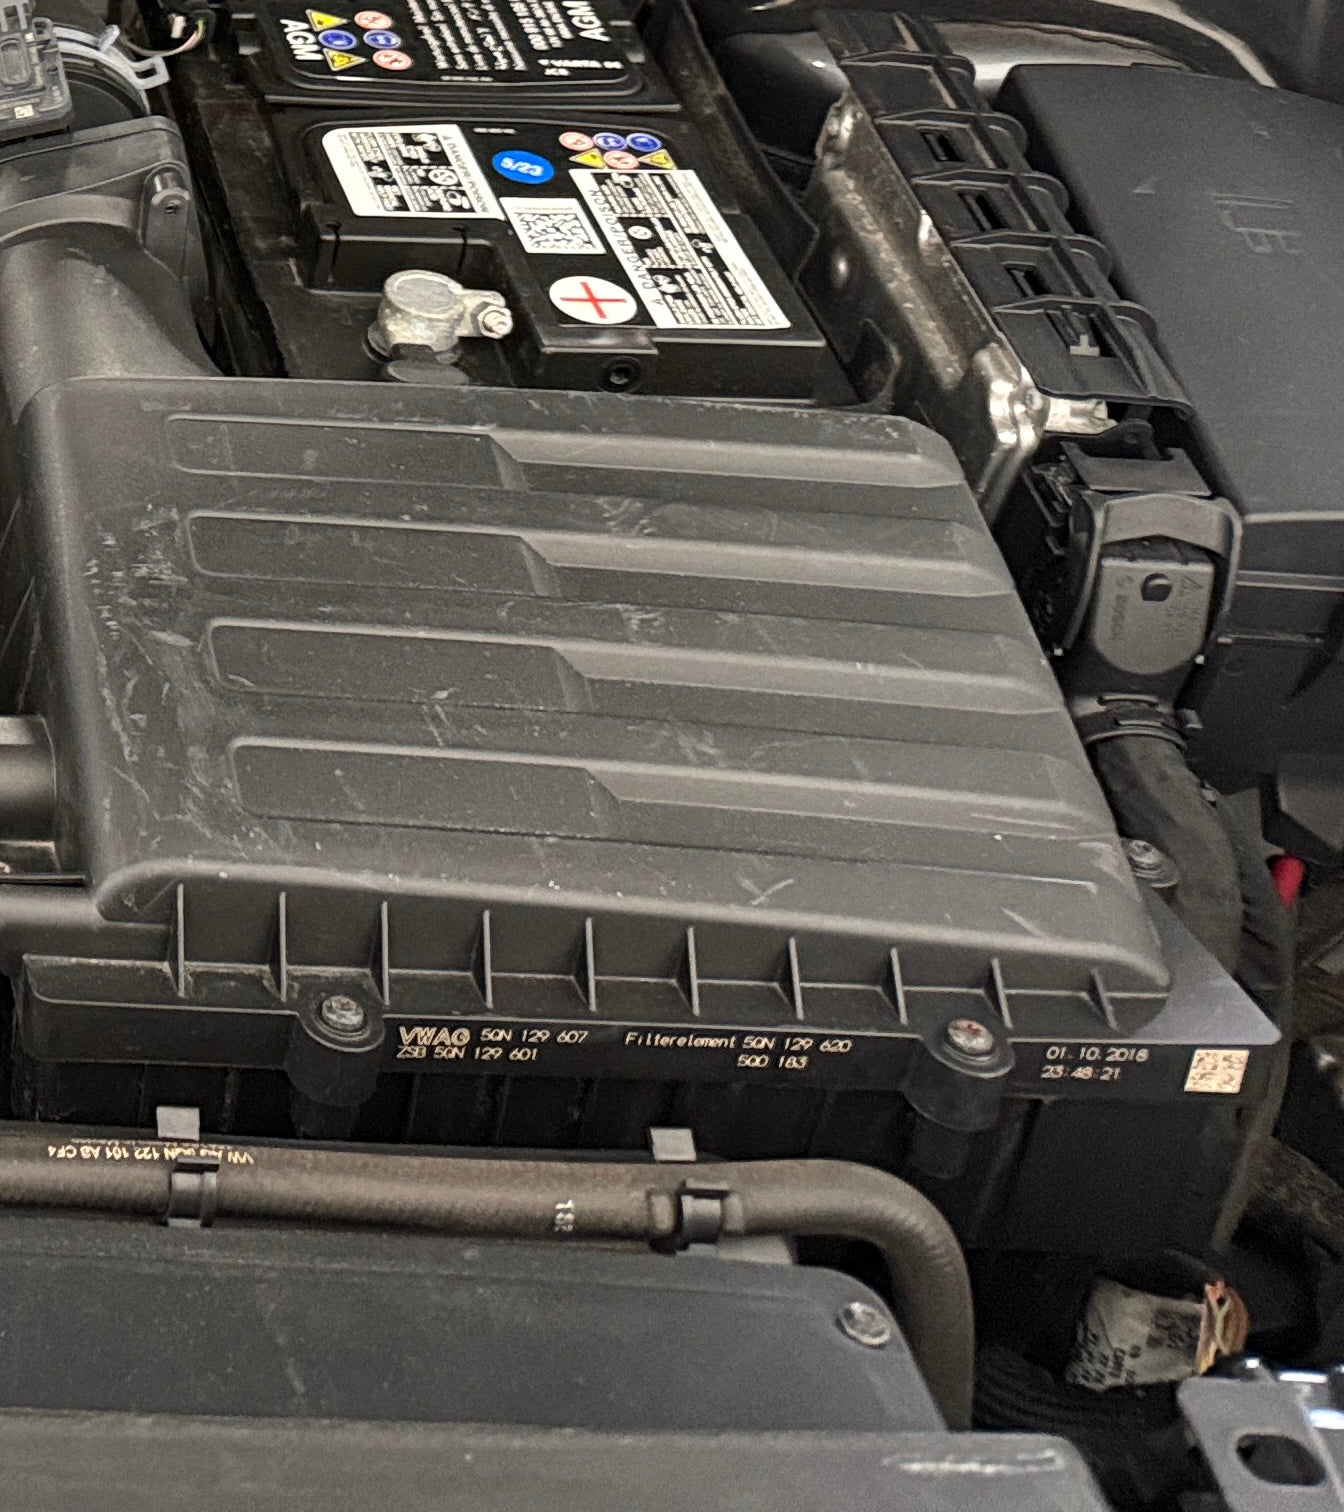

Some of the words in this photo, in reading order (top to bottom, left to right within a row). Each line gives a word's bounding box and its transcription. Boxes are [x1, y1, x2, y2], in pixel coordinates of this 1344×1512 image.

[562, 0, 612, 42] AGM
[279, 19, 324, 61] AGM
[500, 156, 544, 177] 5/23
[398, 1026, 471, 1046] VWAG
[522, 1029, 551, 1043] 129
[557, 1030, 589, 1044] 607
[624, 1031, 737, 1049] Filterelement
[784, 1037, 814, 1051] 129
[819, 1039, 853, 1053] 620
[474, 1046, 503, 1060] 129
[509, 1047, 539, 1061] 601
[104, 1144, 129, 1160] 101
[133, 1145, 160, 1161] 122
[227, 1148, 255, 1165] VW
